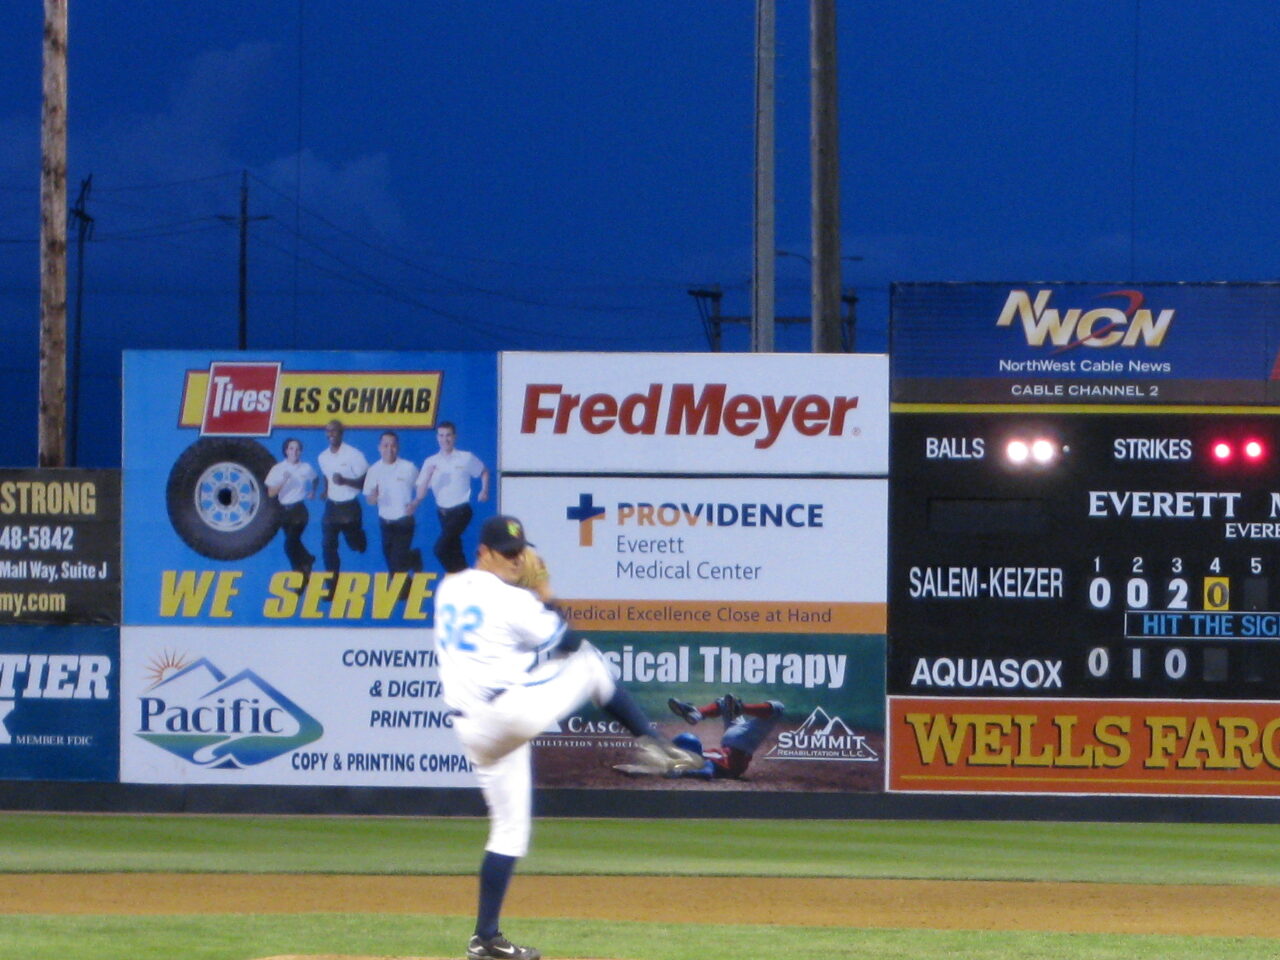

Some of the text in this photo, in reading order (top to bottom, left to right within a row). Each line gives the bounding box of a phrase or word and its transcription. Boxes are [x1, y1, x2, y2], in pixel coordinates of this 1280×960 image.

[996, 290, 1176, 347] NWCN
[1000, 359, 1171, 372] NorthWest Cable News
[211, 376, 273, 417] Tires
[281, 387, 432, 414] LES SCHWAB
[1011, 385, 1158, 396] CABLE CHANNEL 2
[926, 437, 985, 459] BALLS
[1113, 439, 1192, 460] STRIKES
[0, 481, 97, 515] STRONG
[1088, 491, 1242, 517] EVERETT
[617, 502, 824, 528] PROVIDENCE
[0, 526, 74, 550] 48-5842
[617, 535, 685, 553] Everett
[0, 561, 107, 583] Mall Way, Suite J
[616, 561, 762, 580] Medical Center
[1093, 557, 1100, 572] 1
[1132, 557, 1143, 572] 2
[1171, 557, 1182, 573] 3
[1209, 558, 1221, 573] 4
[1251, 558, 1262, 573] 5
[158, 570, 438, 620] WE SERVE
[909, 567, 1063, 598] SALEM-KEIZER
[1089, 577, 1111, 608] 0
[1127, 577, 1149, 609] 0
[1168, 578, 1188, 609] 2
[1206, 582, 1230, 609] 0
[558, 605, 832, 622] Medical Excellence Close at Hand
[1142, 614, 1183, 635] HIT
[1190, 615, 1234, 636] THE
[440, 603, 483, 652] 32
[0, 654, 111, 699] TIER
[699, 646, 847, 689] Therapy
[910, 657, 1063, 688] AQUASOX
[1088, 648, 1109, 677] 0
[1165, 648, 1187, 679] 0
[369, 680, 382, 697] &
[137, 697, 285, 733] Pacific
[370, 710, 455, 728] PRINTING
[16, 735, 93, 745] MEMBER FDIC
[778, 732, 865, 749] SUMMIT
[905, 713, 1133, 769] WELLS
[291, 753, 328, 771] COPY
[333, 753, 342, 771] &
[347, 753, 415, 772] PRINTING
